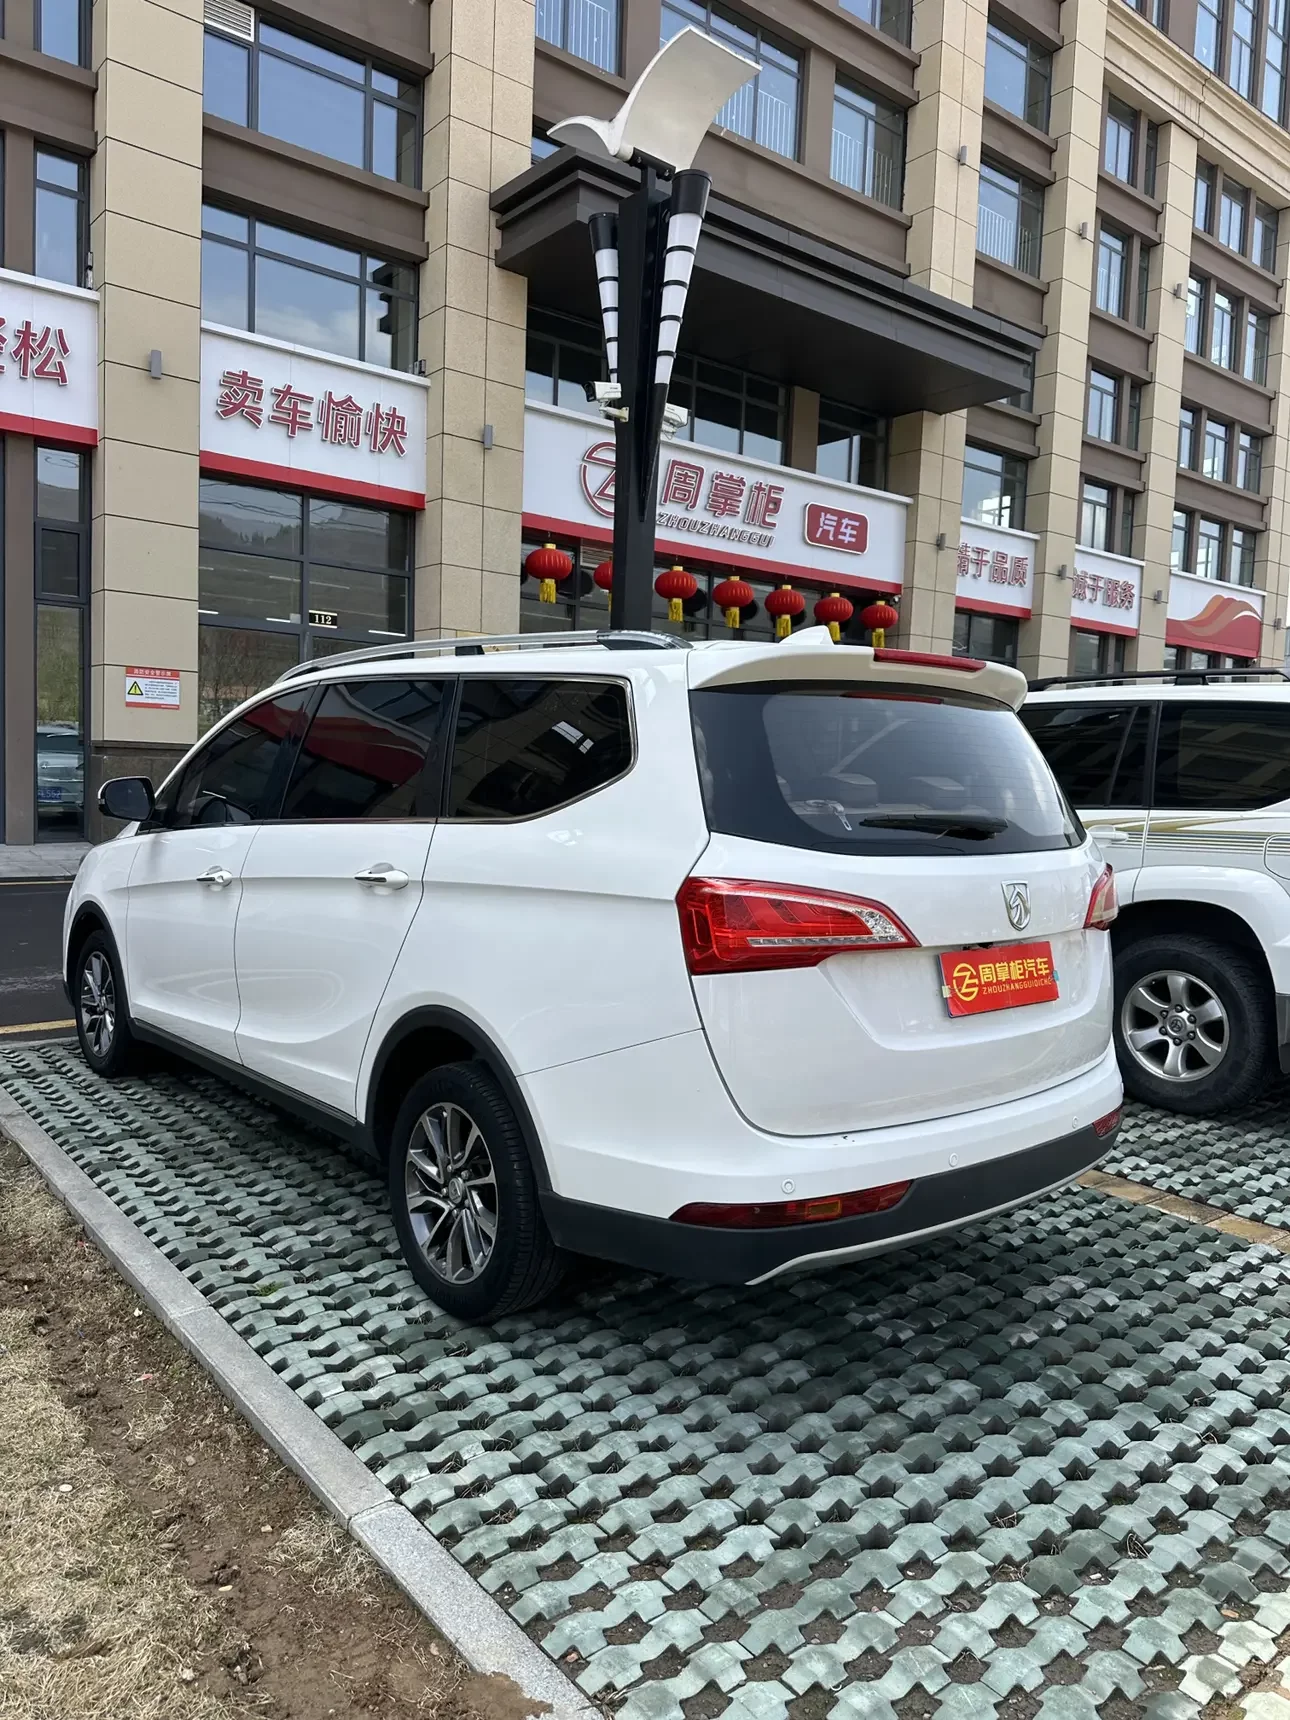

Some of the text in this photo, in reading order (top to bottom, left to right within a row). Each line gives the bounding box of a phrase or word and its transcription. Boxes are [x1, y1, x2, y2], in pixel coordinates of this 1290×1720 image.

[216, 368, 409, 458] 卖车愉快
[661, 458, 785, 529] 周掌柜
[656, 511, 776, 548] ZHOUZHANGGUI
[815, 511, 860, 544] 汽车
[314, 614, 332, 625] 112
[978, 957, 1050, 985] 周掌柜汽车
